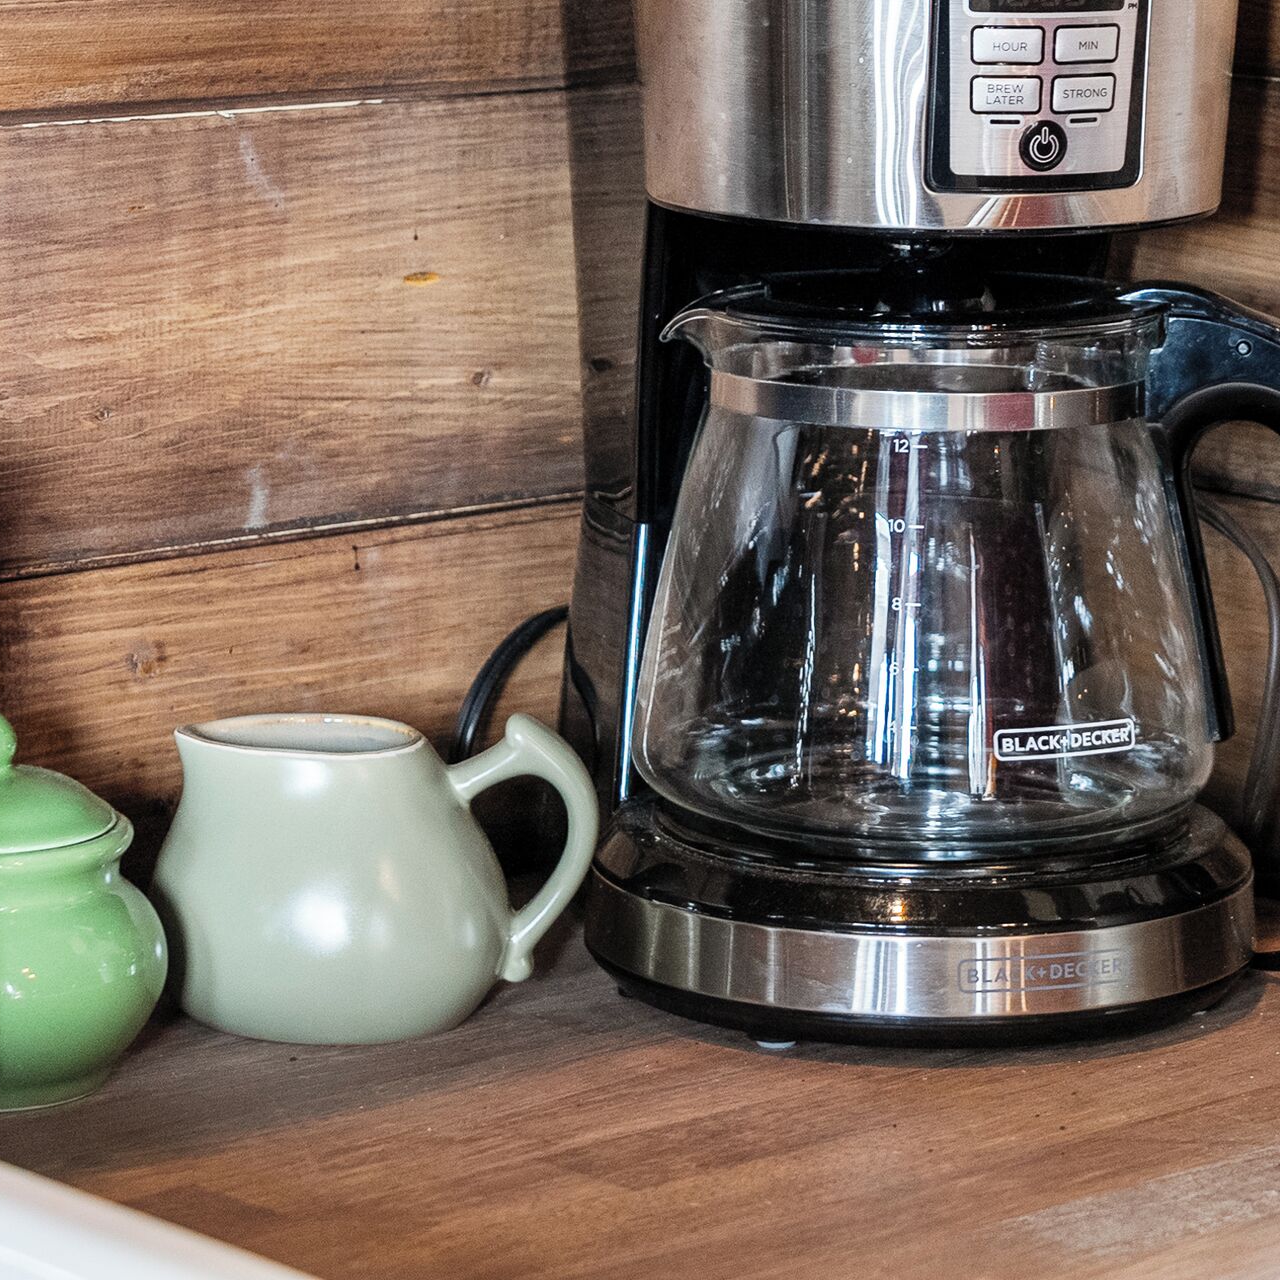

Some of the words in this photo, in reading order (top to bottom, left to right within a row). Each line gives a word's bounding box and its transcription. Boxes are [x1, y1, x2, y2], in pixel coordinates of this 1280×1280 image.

[992, 42, 1028, 52] HOUR
[1078, 41, 1099, 51] MIN
[987, 84, 1024, 94] BREW
[1063, 88, 1108, 99] STRONG
[986, 95, 1024, 105] LATER
[893, 439, 909, 453] 12
[888, 519, 905, 533] 10
[891, 597, 902, 611] 8
[889, 662, 899, 675] 6
[1001, 727, 1130, 753] BLACK+DECKER
[967, 958, 1122, 984] BLAK+DECER
